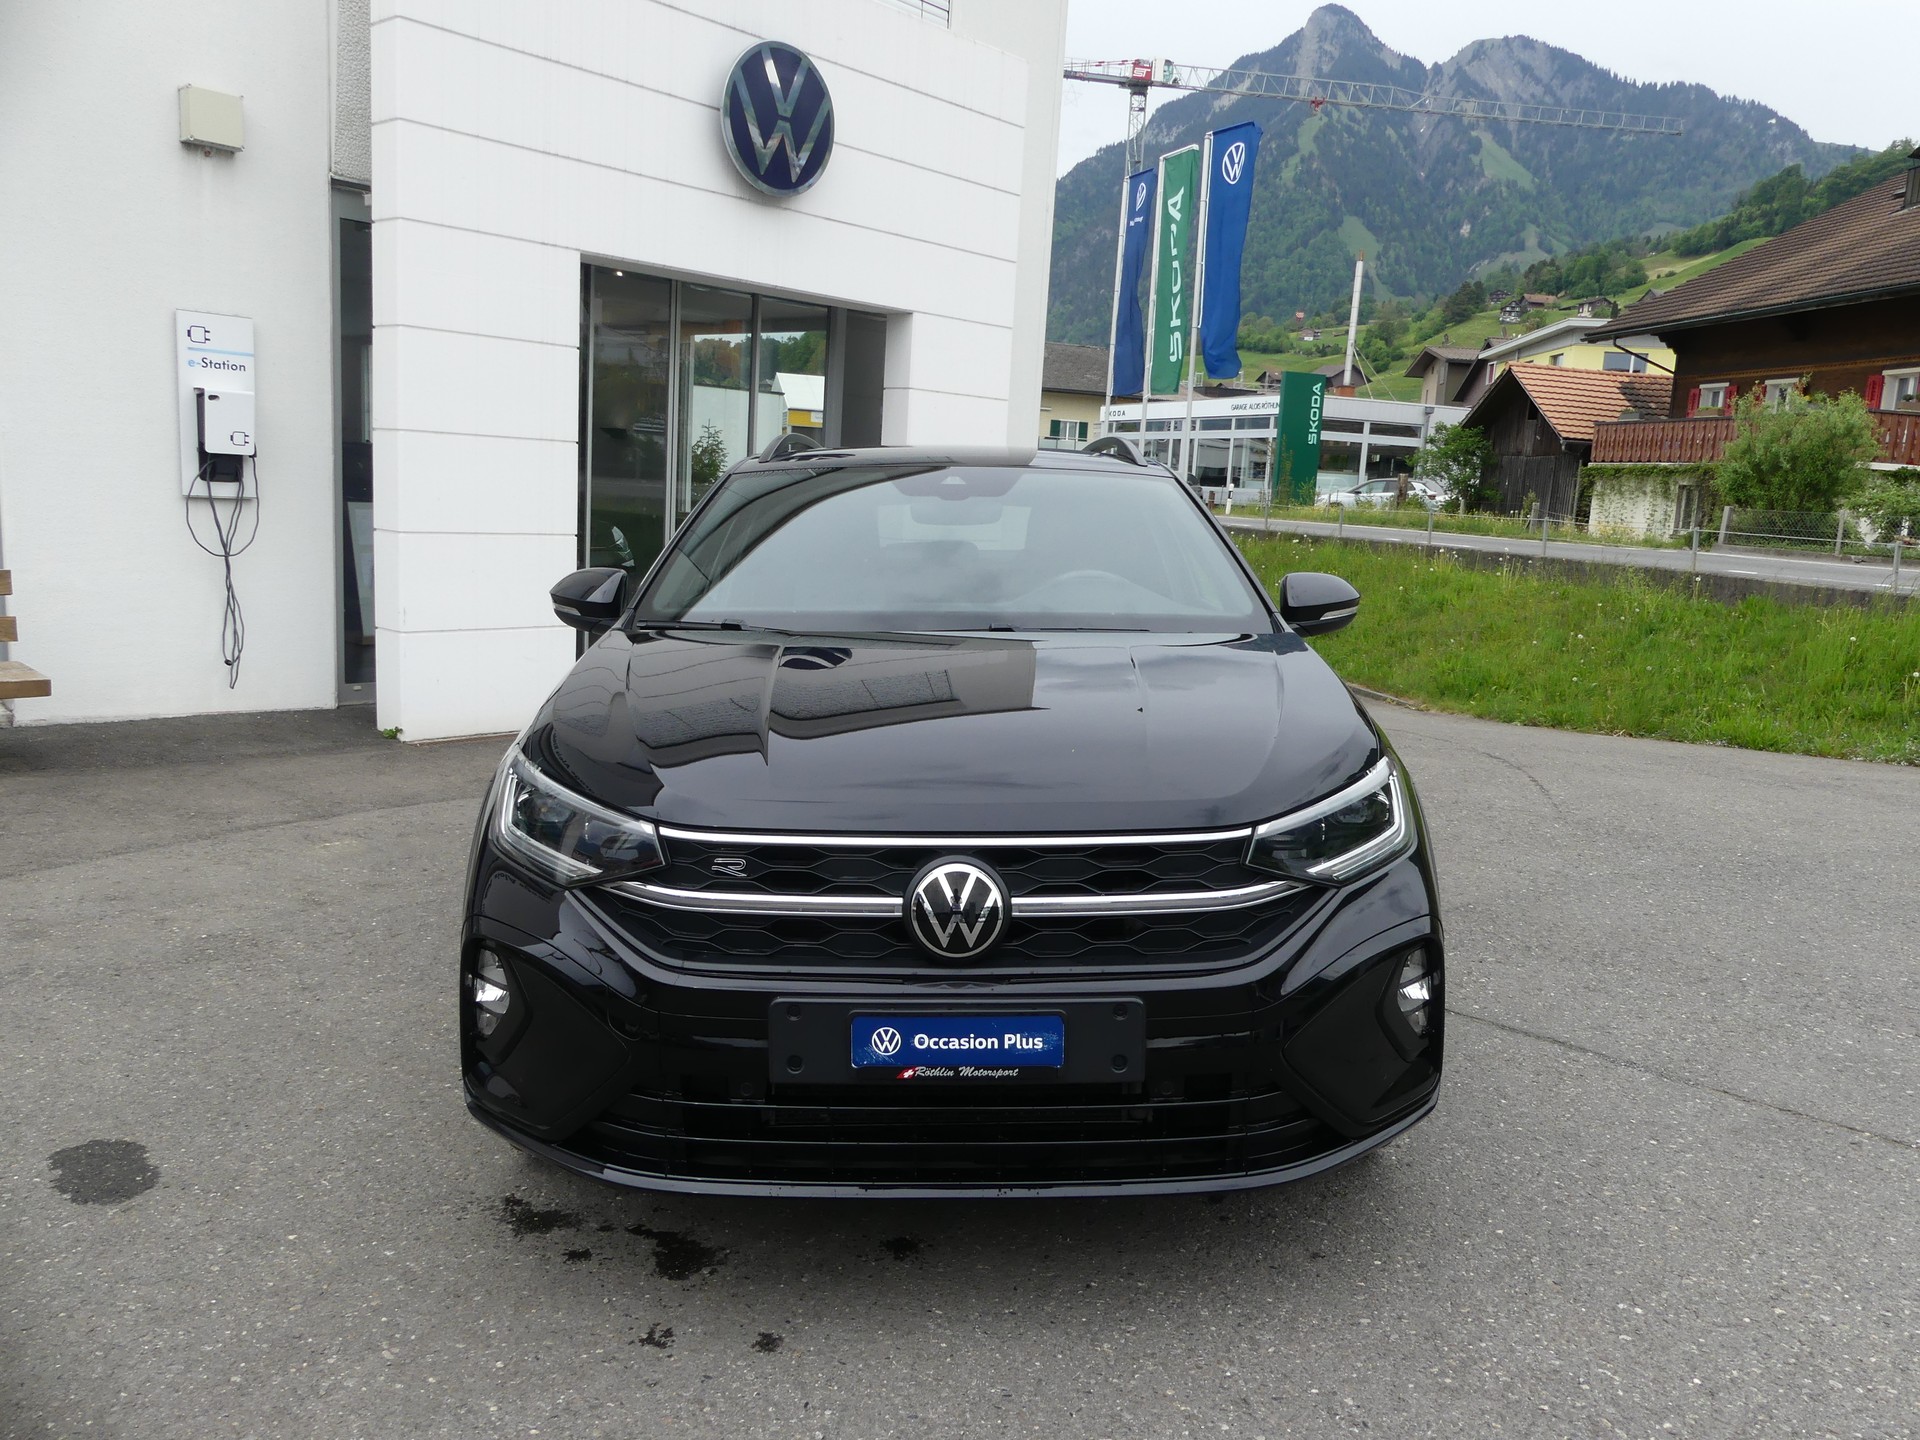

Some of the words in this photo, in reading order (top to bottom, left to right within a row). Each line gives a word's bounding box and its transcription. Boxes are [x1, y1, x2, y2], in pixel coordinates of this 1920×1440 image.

[188, 357, 246, 372] e-Station
[1231, 403, 1248, 411] GARAGE
[914, 1033, 998, 1050] Occasion
[1004, 1033, 1044, 1050] Plus
[914, 1066, 955, 1077] Röthlin
[958, 1066, 1019, 1079] Motorsport
